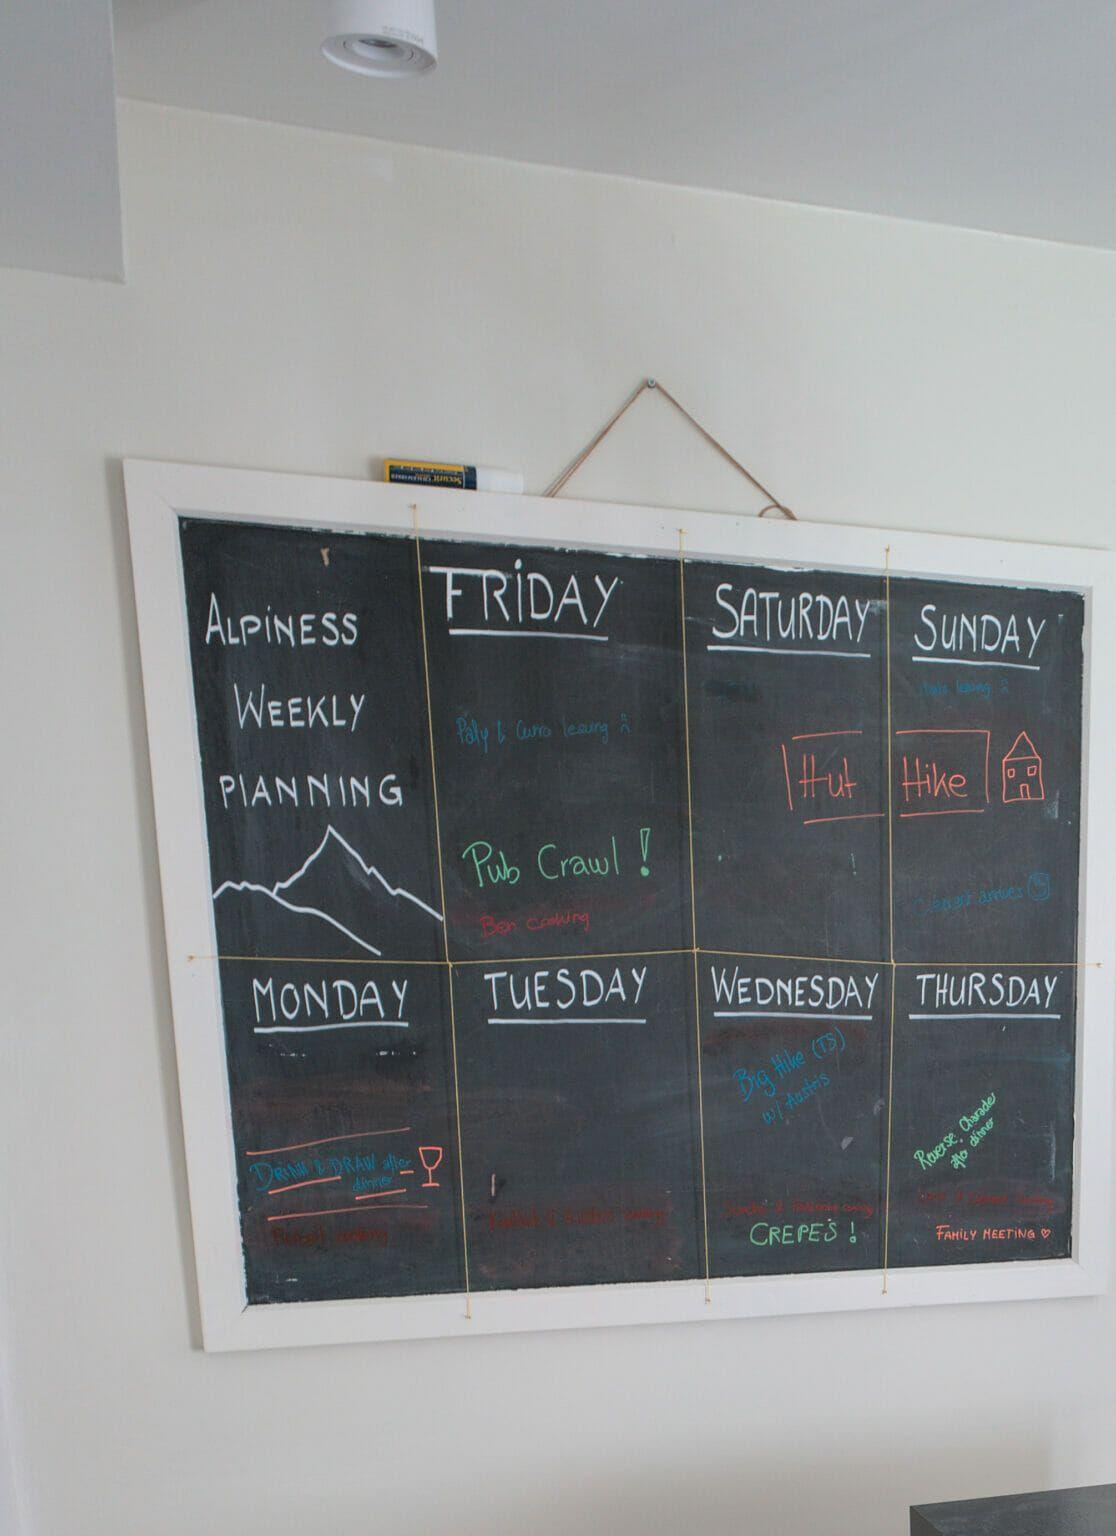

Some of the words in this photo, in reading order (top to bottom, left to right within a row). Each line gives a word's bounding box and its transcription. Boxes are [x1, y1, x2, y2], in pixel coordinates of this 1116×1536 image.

[427, 559, 618, 627] FRIDAY
[712, 583, 869, 642] SATURDAY
[205, 592, 358, 647] ALPINESS
[914, 604, 1045, 658] SUNDAY
[233, 682, 365, 732] WEEKLY
[799, 753, 857, 798] Hut
[902, 756, 968, 802] Hike
[462, 841, 520, 887] Pub
[537, 836, 620, 880] Crawl
[253, 977, 409, 1024] MONDAY
[484, 966, 648, 1010] TUESDAY
[711, 966, 879, 1010] WEDNESDAY
[916, 972, 1058, 1008] THURSDAY
